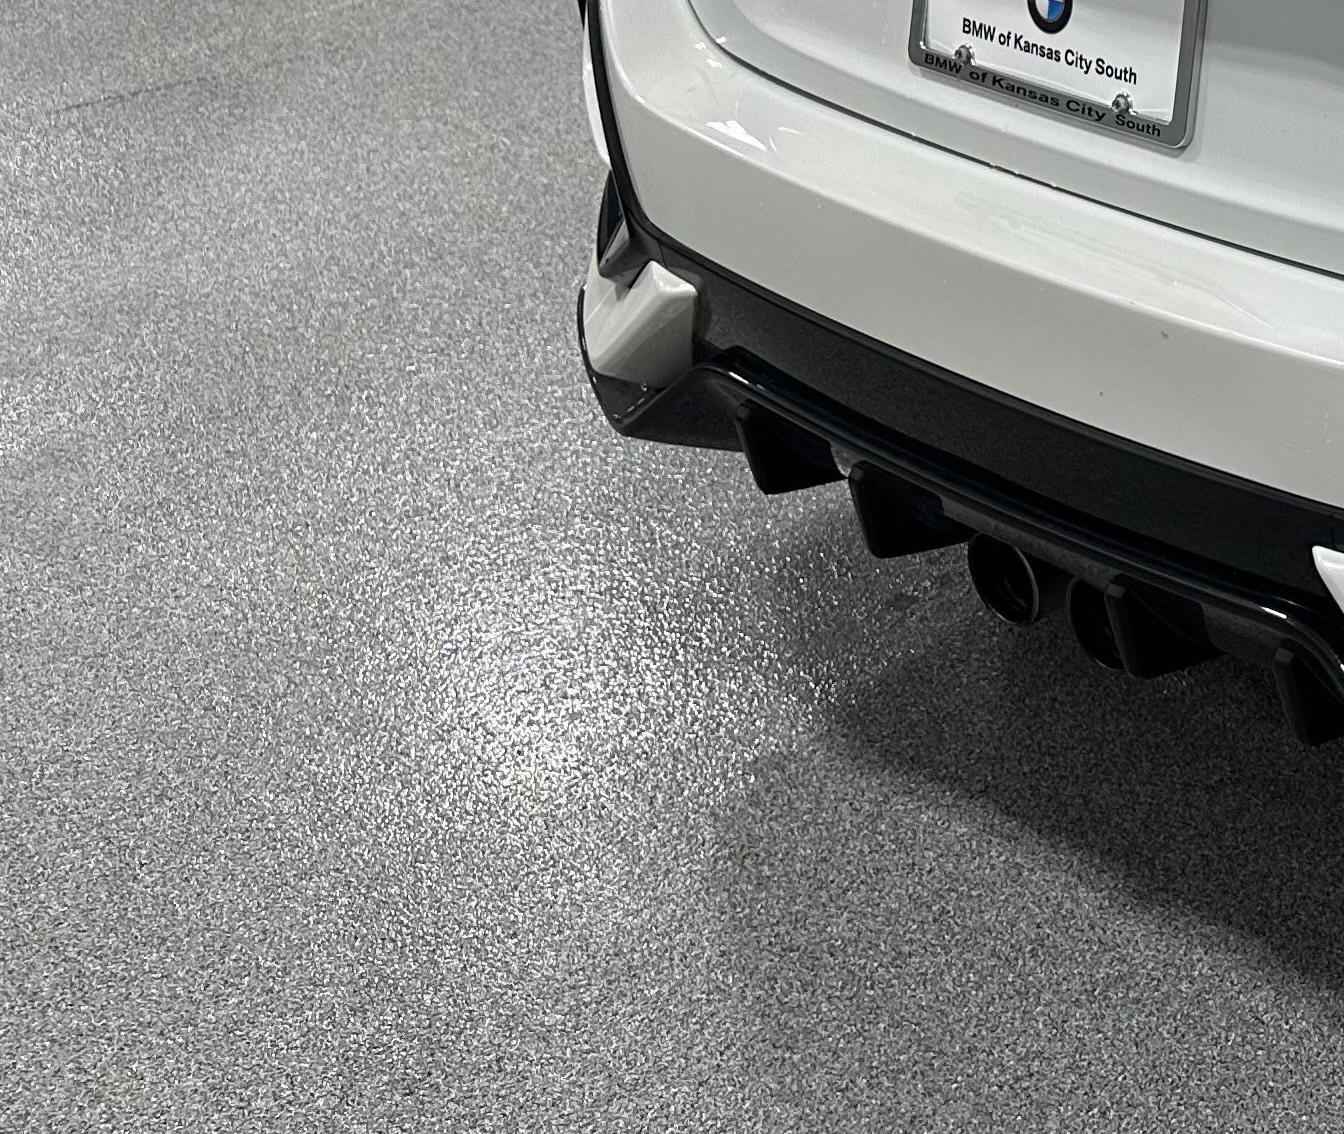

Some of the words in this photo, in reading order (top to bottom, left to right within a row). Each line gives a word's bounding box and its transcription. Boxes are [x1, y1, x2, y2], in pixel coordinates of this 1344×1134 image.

[962, 17, 996, 43] BMW
[997, 31, 1012, 47] of
[1013, 34, 1061, 63] Kansas
[1064, 49, 1093, 75] City
[1095, 57, 1137, 85] South
[924, 53, 962, 75] BMW
[968, 69, 989, 84] of
[991, 74, 1060, 107] Kansas
[1065, 98, 1106, 123] City
[1114, 113, 1162, 138] South
